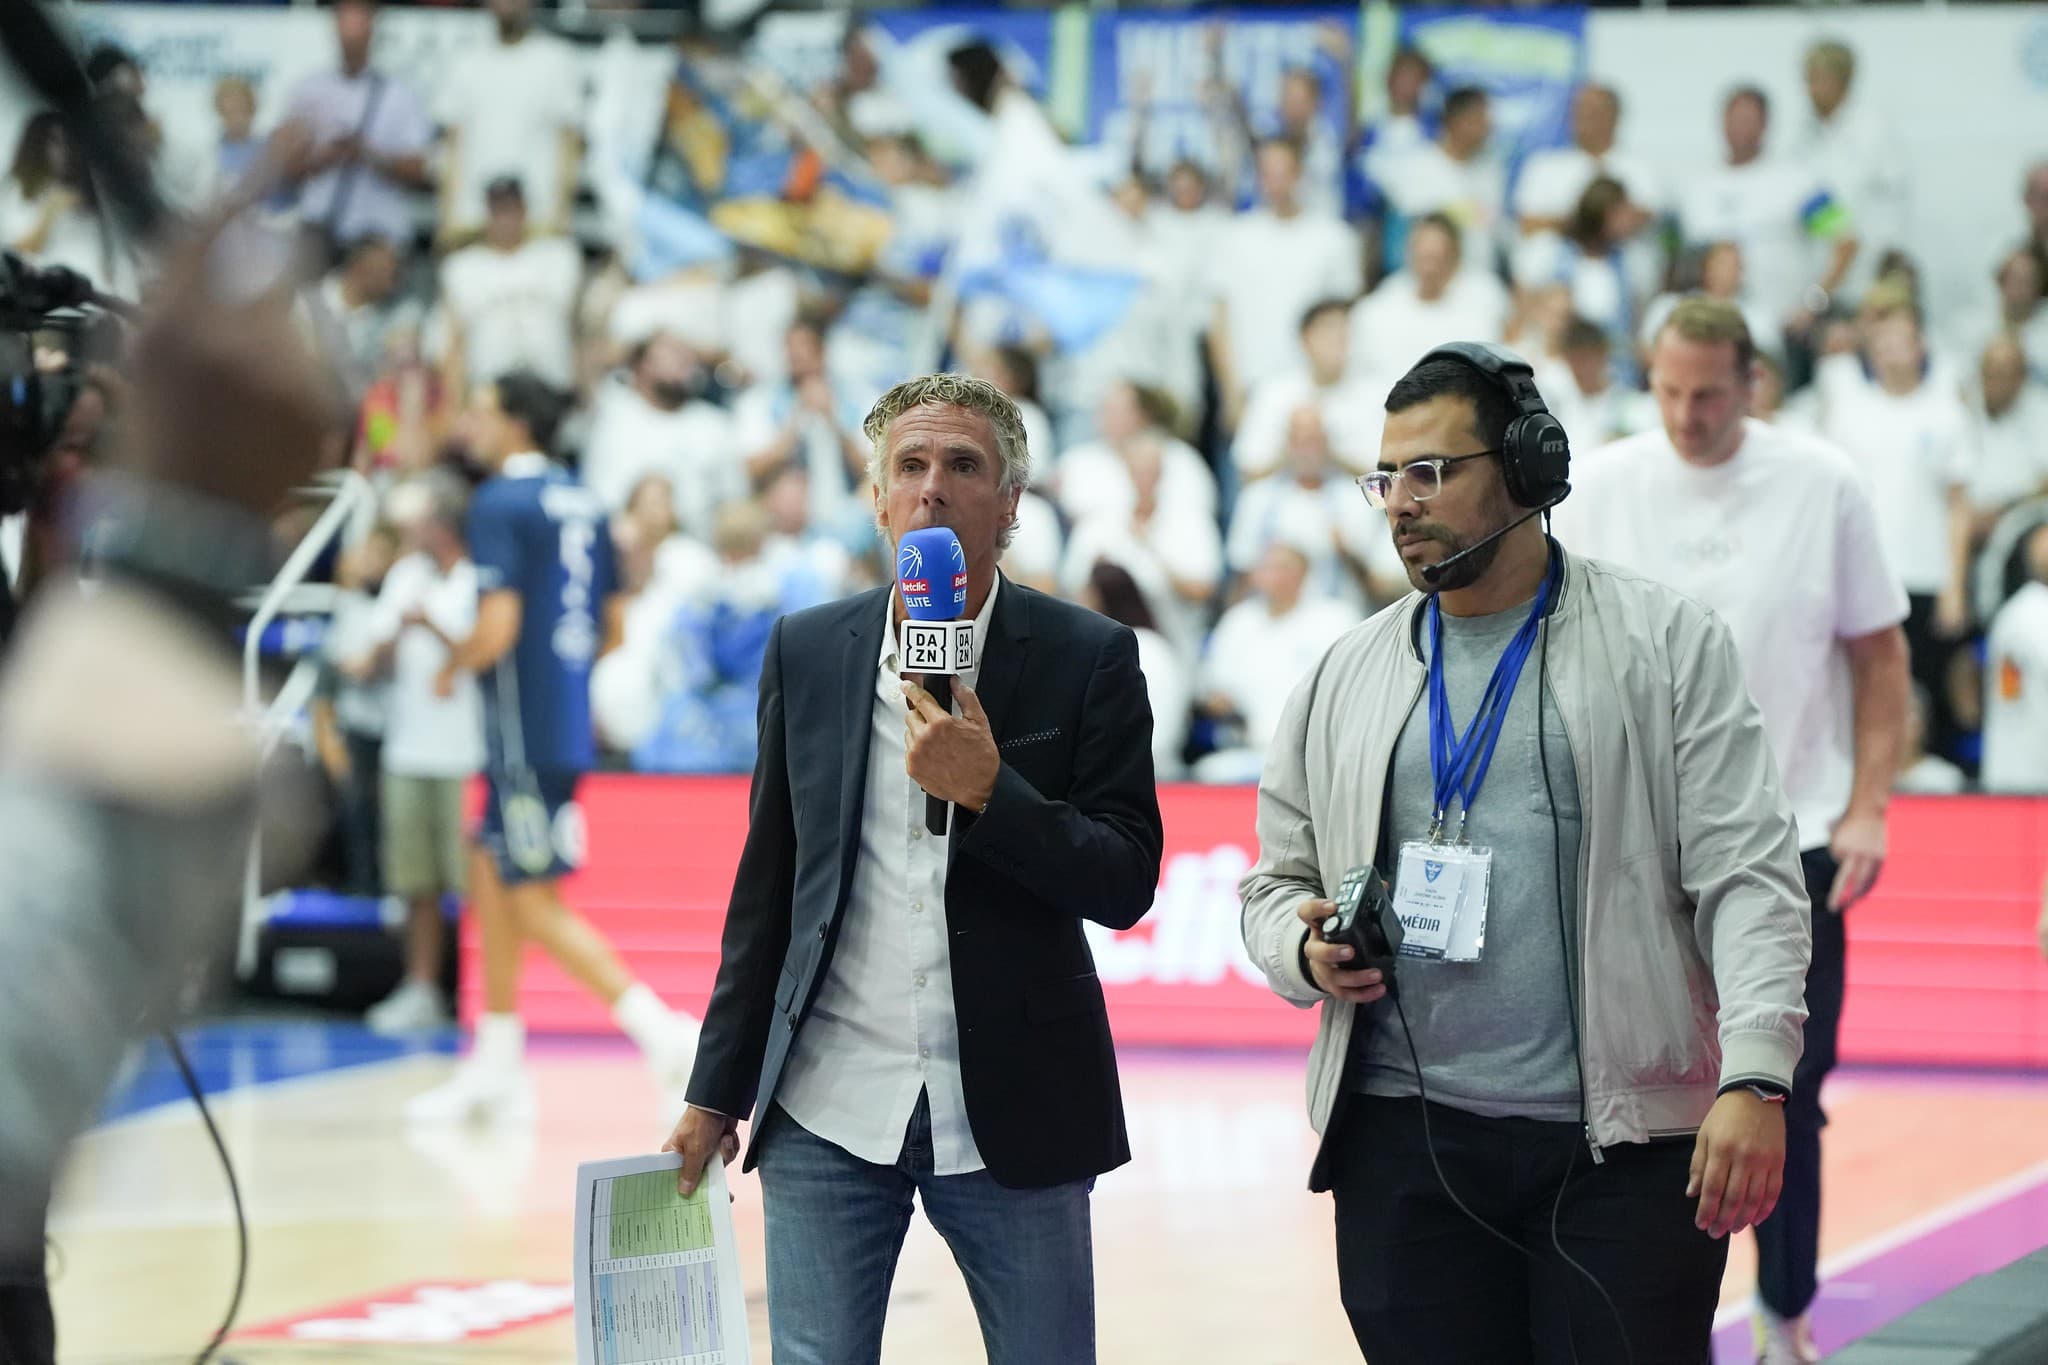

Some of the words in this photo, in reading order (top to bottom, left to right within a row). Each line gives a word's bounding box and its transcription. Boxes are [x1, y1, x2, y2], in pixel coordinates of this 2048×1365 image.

[1542, 440, 1565, 454] RTS
[902, 581, 926, 592] Betclic
[1400, 913, 1440, 932] MÉDIA
